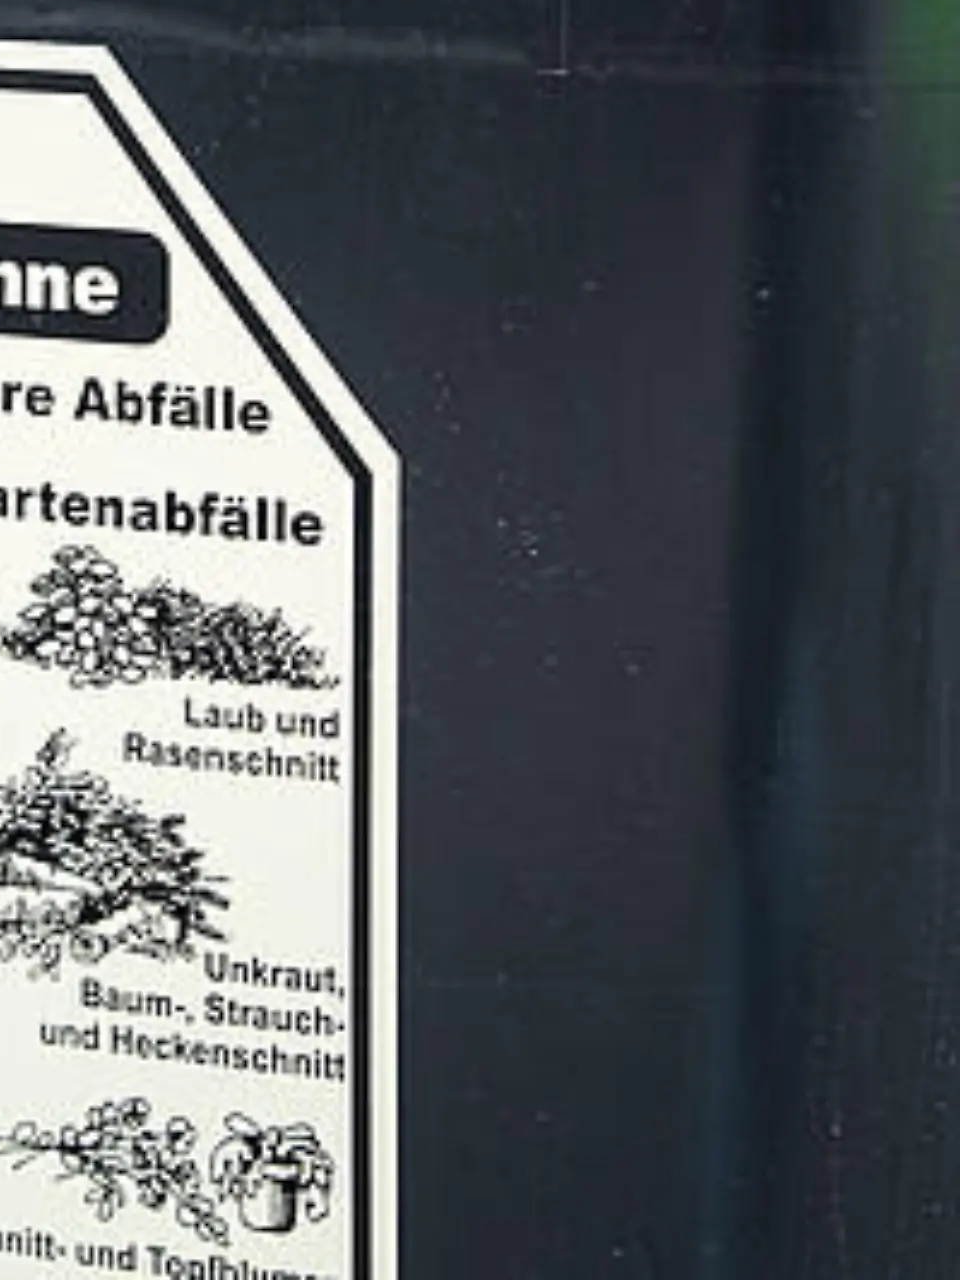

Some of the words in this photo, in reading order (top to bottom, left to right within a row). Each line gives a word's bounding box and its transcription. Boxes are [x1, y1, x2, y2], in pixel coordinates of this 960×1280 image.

[74, 375, 272, 435] Abfälle
[184, 697, 265, 734] Laub
[275, 708, 341, 740] und
[123, 732, 341, 784] Rasenschnitt
[205, 952, 345, 998] Unkraut,
[80, 976, 194, 1023] Baum-,
[205, 996, 346, 1037] Strauch-
[40, 1019, 100, 1051] und
[109, 1022, 346, 1083] Heckenschnitt
[75, 1240, 137, 1271] und
